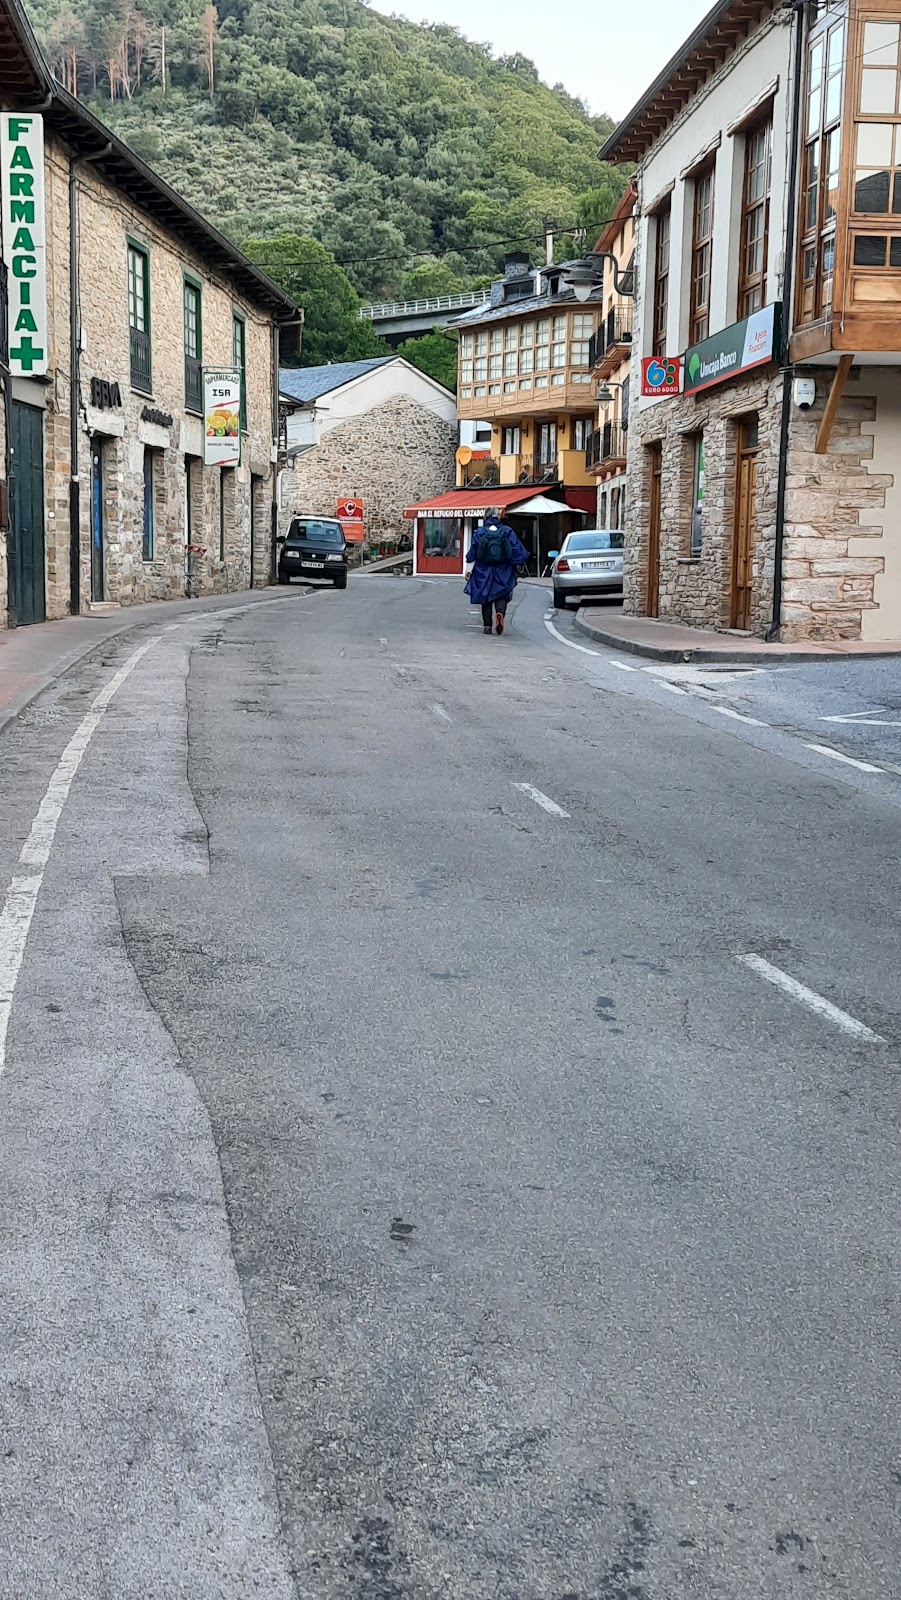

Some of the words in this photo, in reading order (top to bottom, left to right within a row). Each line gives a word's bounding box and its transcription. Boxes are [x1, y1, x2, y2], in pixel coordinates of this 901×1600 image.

[8, 117, 38, 332] FARMACIA
[754, 328, 768, 343] Agente
[748, 340, 768, 355] Financiero
[699, 353, 720, 379] Unicaja
[719, 350, 737, 370] Banco
[205, 374, 240, 385] SUPERMERCADO
[90, 376, 122, 410] BBVA
[212, 388, 231, 397] ISA
[417, 510, 427, 518] BAR
[428, 510, 433, 518] EL
[433, 510, 454, 518] REFUGIO
[454, 509, 463, 517] DEL
